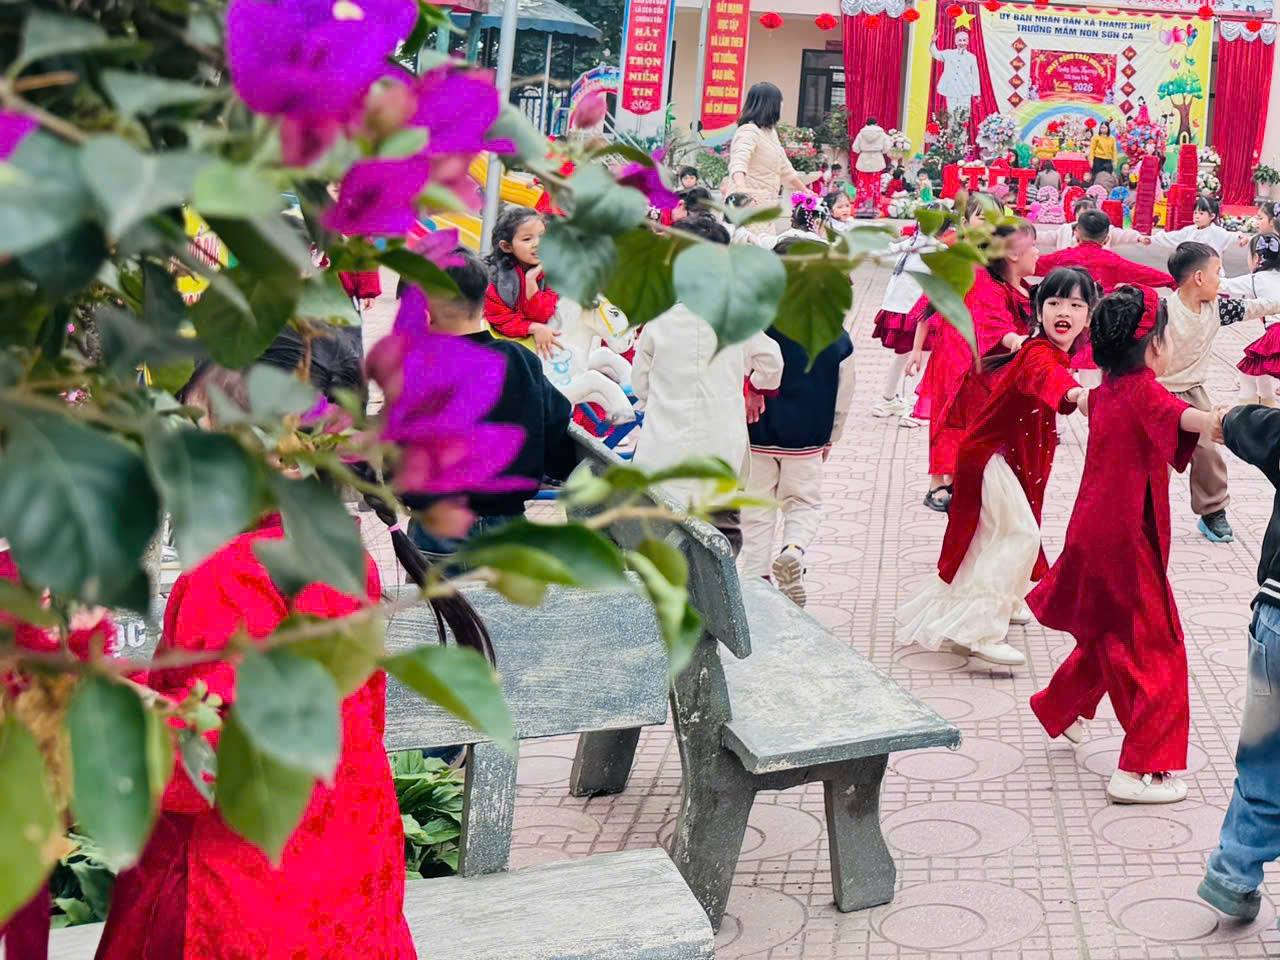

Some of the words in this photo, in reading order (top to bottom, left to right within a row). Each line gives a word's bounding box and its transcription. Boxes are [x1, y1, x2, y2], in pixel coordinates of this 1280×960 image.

[1079, 28, 1099, 38] NON
[629, 56, 661, 67] TRỌN
[631, 87, 654, 96] TIN
[1073, 82, 1094, 92] 2026
